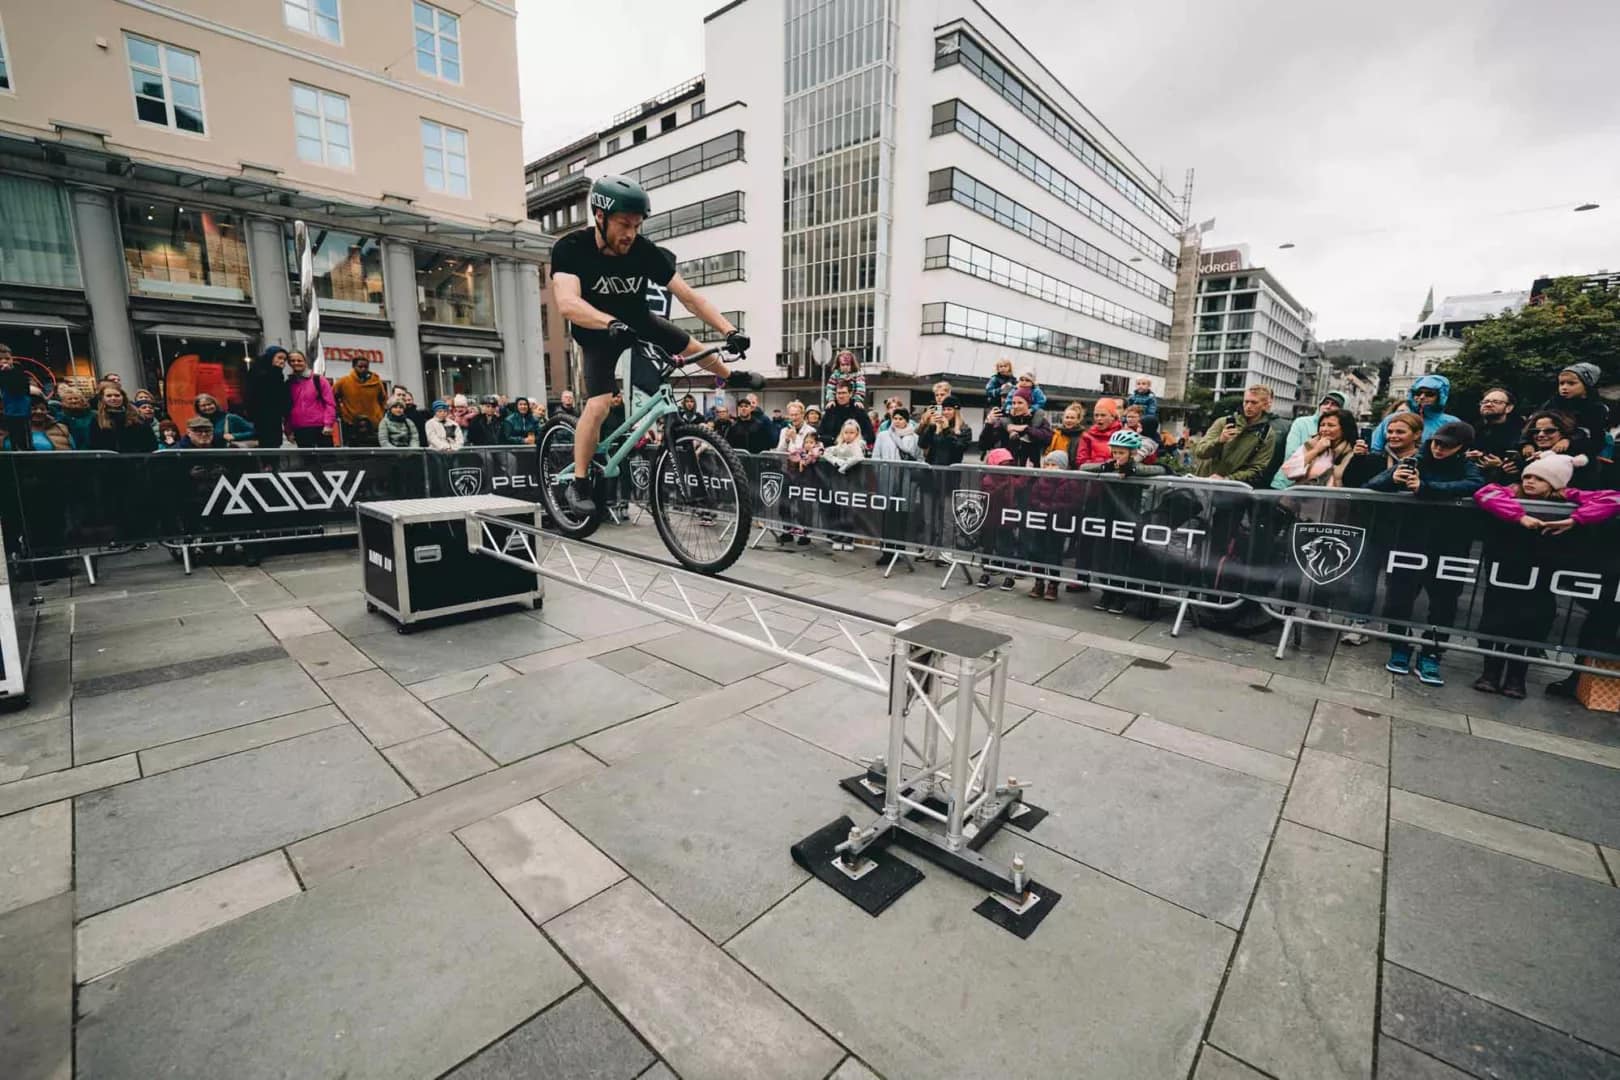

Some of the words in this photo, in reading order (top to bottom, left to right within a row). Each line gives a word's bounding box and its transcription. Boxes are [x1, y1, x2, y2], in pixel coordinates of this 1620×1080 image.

[788, 485, 907, 512] PEUGEOT
[1001, 508, 1206, 549] PEUGEOT
[1299, 526, 1360, 538] PEUGEOT
[1386, 550, 1620, 602] PEUG
